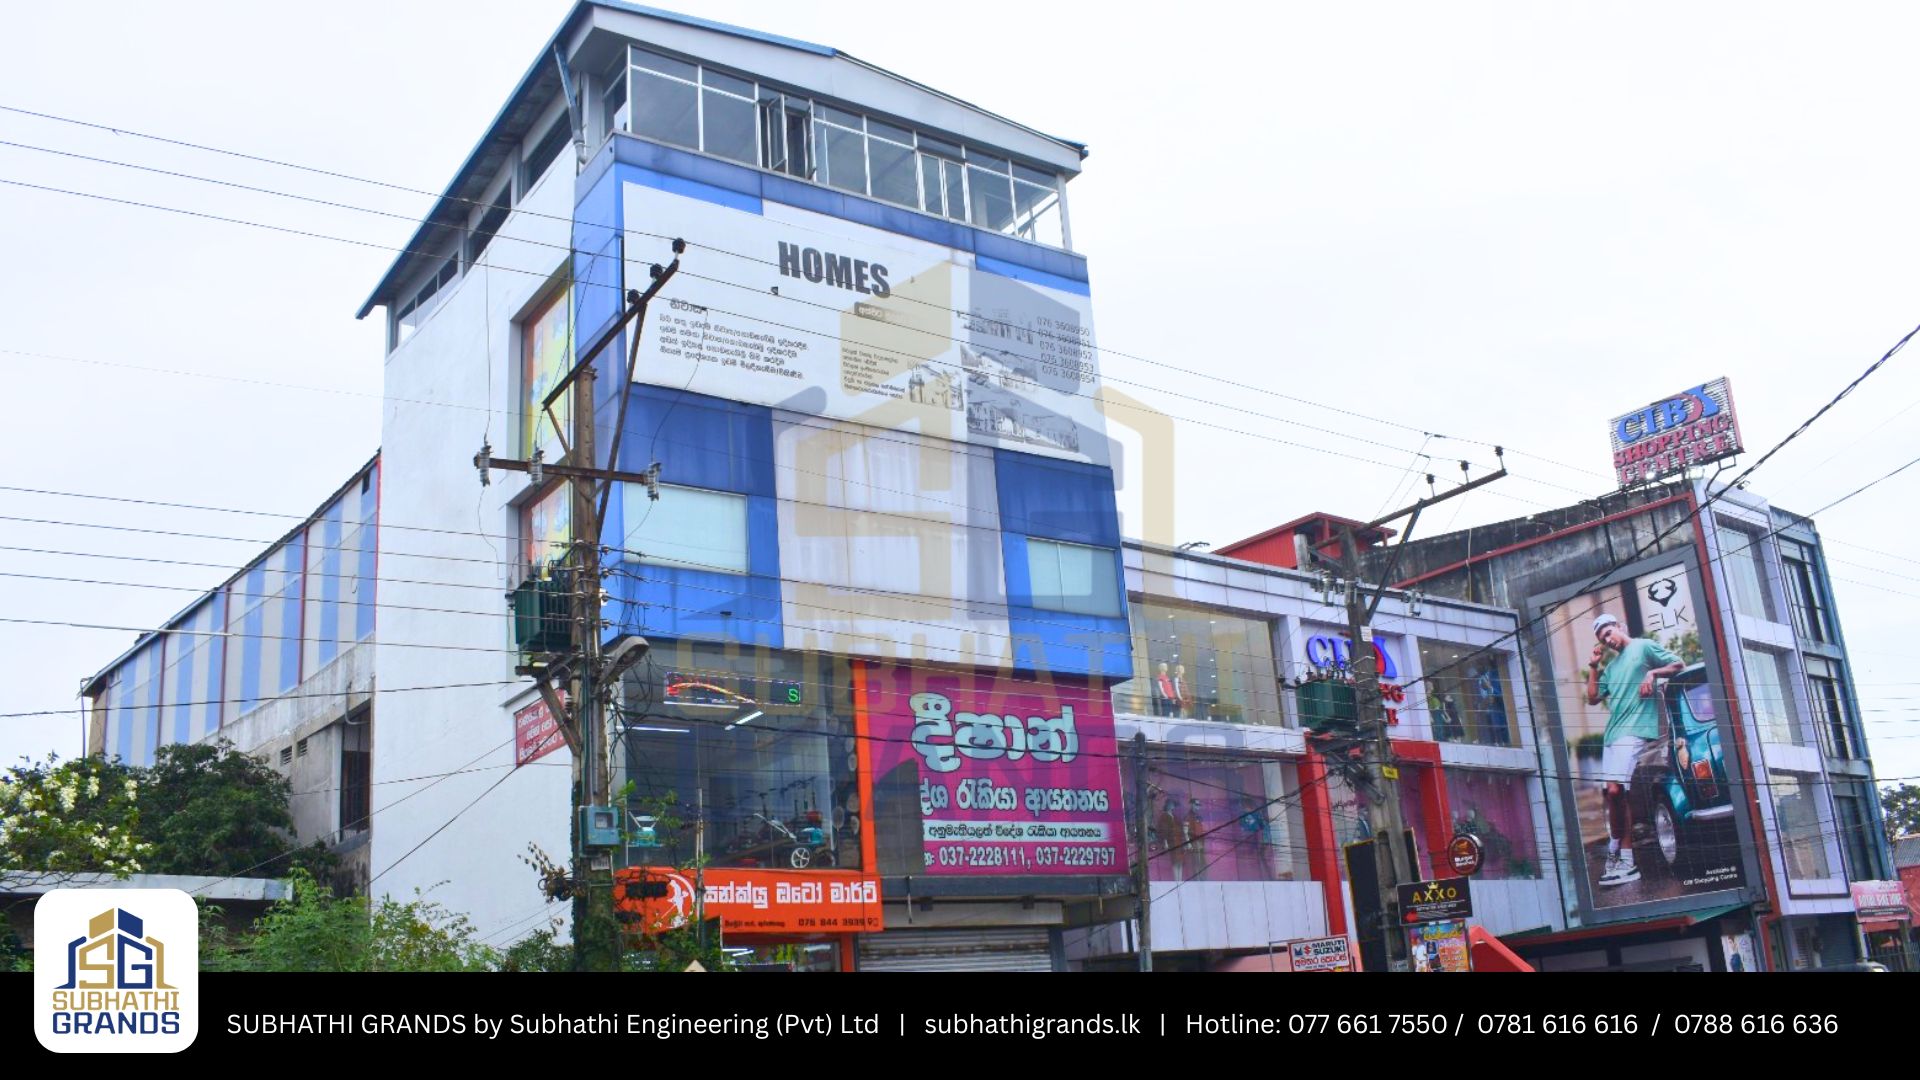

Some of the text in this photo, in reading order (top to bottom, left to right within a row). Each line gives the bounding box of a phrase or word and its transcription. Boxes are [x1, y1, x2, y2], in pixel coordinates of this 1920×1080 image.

[777, 240, 891, 298] HOMES
[1613, 412, 1732, 468] SHOPPING
[1620, 433, 1730, 484] CENTRE
[1024, 788, 1109, 817] ආයතනය
[938, 847, 1032, 871] 037-2228111,
[1036, 847, 1116, 866] 037-2229797
[1412, 887, 1457, 904] AXXO
[1311, 939, 1345, 949] MARUTI
[1313, 945, 1346, 956] SUZUKI
